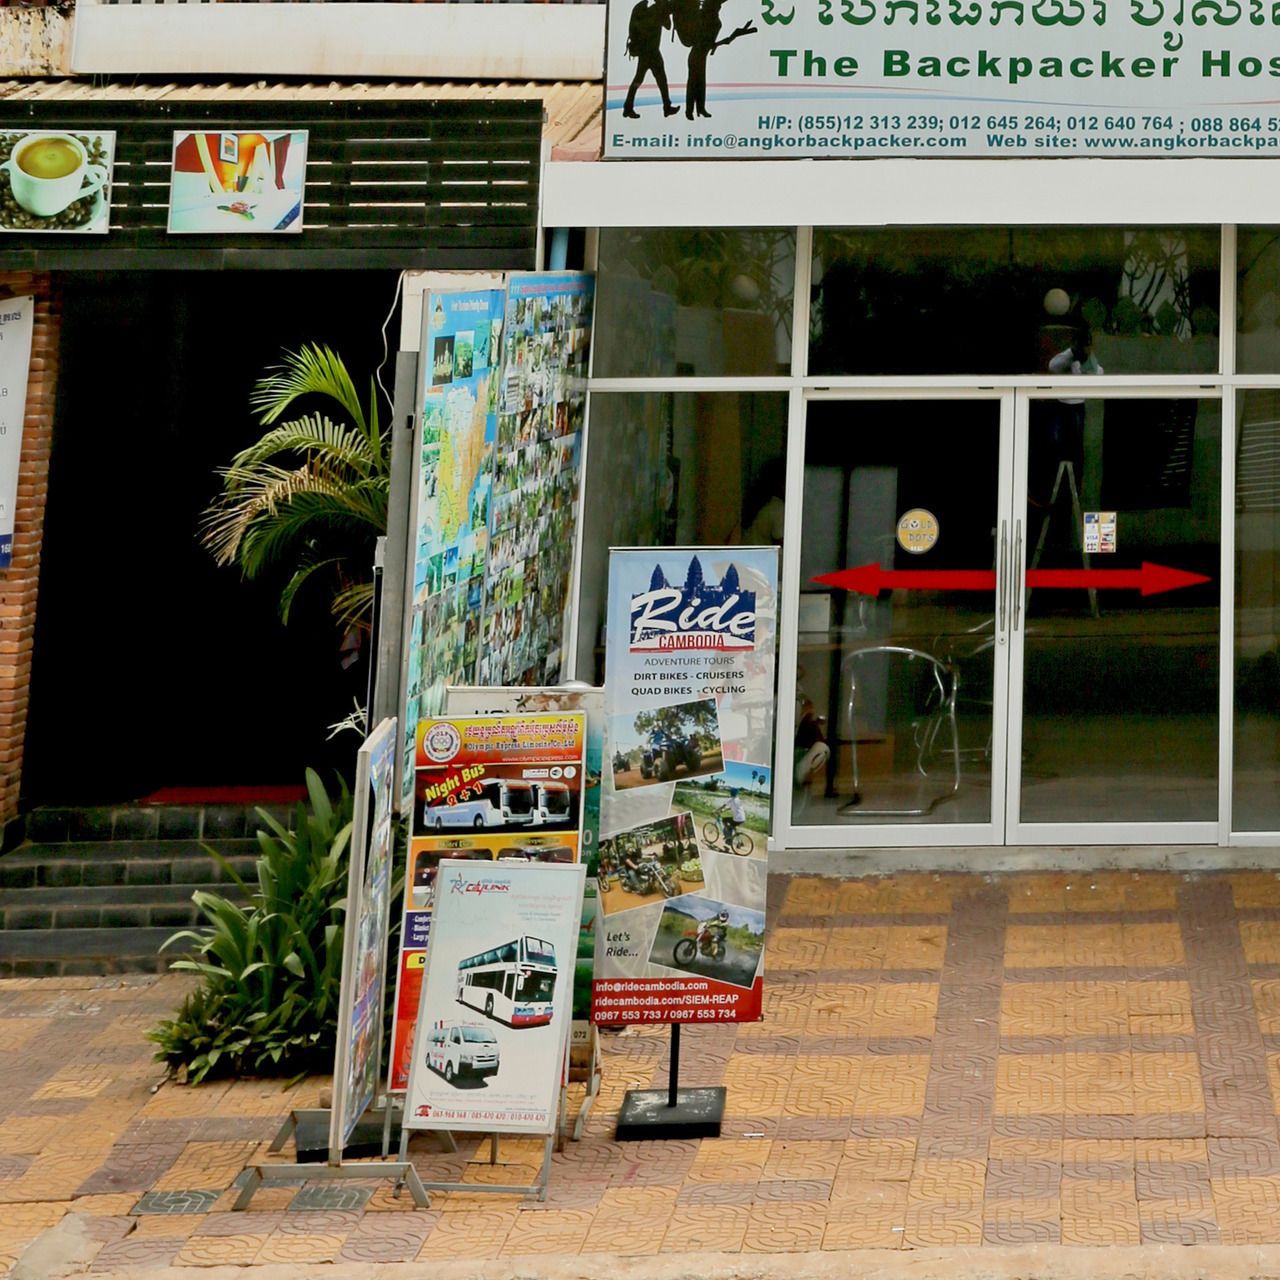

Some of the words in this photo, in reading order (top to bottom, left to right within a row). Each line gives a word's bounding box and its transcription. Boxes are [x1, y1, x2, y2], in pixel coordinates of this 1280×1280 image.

[770, 49, 859, 78] The
[884, 49, 1179, 84] Backpacker
[758, 115, 792, 130] H/P:
[798, 114, 864, 133] (855)12
[870, 116, 902, 130] 313
[906, 116, 943, 133] 239;
[949, 116, 982, 130] 012
[986, 116, 1020, 131] 645
[1024, 116, 1061, 133] 264;
[1067, 116, 1098, 131] 012
[1106, 116, 1136, 131] 640
[1142, 116, 1173, 131] 764
[1190, 117, 1225, 132] 088
[1229, 117, 1262, 132] 864
[612, 134, 680, 148] E-mail:
[686, 134, 967, 150] info@angkorbackpacker.com
[987, 134, 1028, 147] Web
[1034, 133, 1078, 148] site:
[631, 589, 755, 643] Ride
[658, 634, 725, 649] CAMBODIA
[644, 657, 700, 666] ADVENTURE
[704, 656, 735, 665] TOURS
[634, 673, 657, 681] DIRT
[660, 672, 688, 680] BIKES
[696, 671, 744, 680] CRUISERS
[632, 687, 661, 696] QUAD
[664, 686, 692, 695] BIKES
[702, 685, 746, 695] CYCLING
[425, 773, 460, 802] Night
[461, 764, 486, 784] Bus
[606, 931, 631, 942] Let's
[606, 946, 639, 957] Ride...
[596, 981, 708, 992] info@ridecambodia.com
[595, 994, 739, 1006] ridecambodia.com/SIEM-REAP
[595, 1011, 618, 1021] 0967
[621, 1011, 640, 1020] 553
[642, 1010, 661, 1020] 733
[670, 1010, 694, 1019] 0967
[697, 1010, 716, 1019] 553
[718, 1009, 736, 1019] 734
